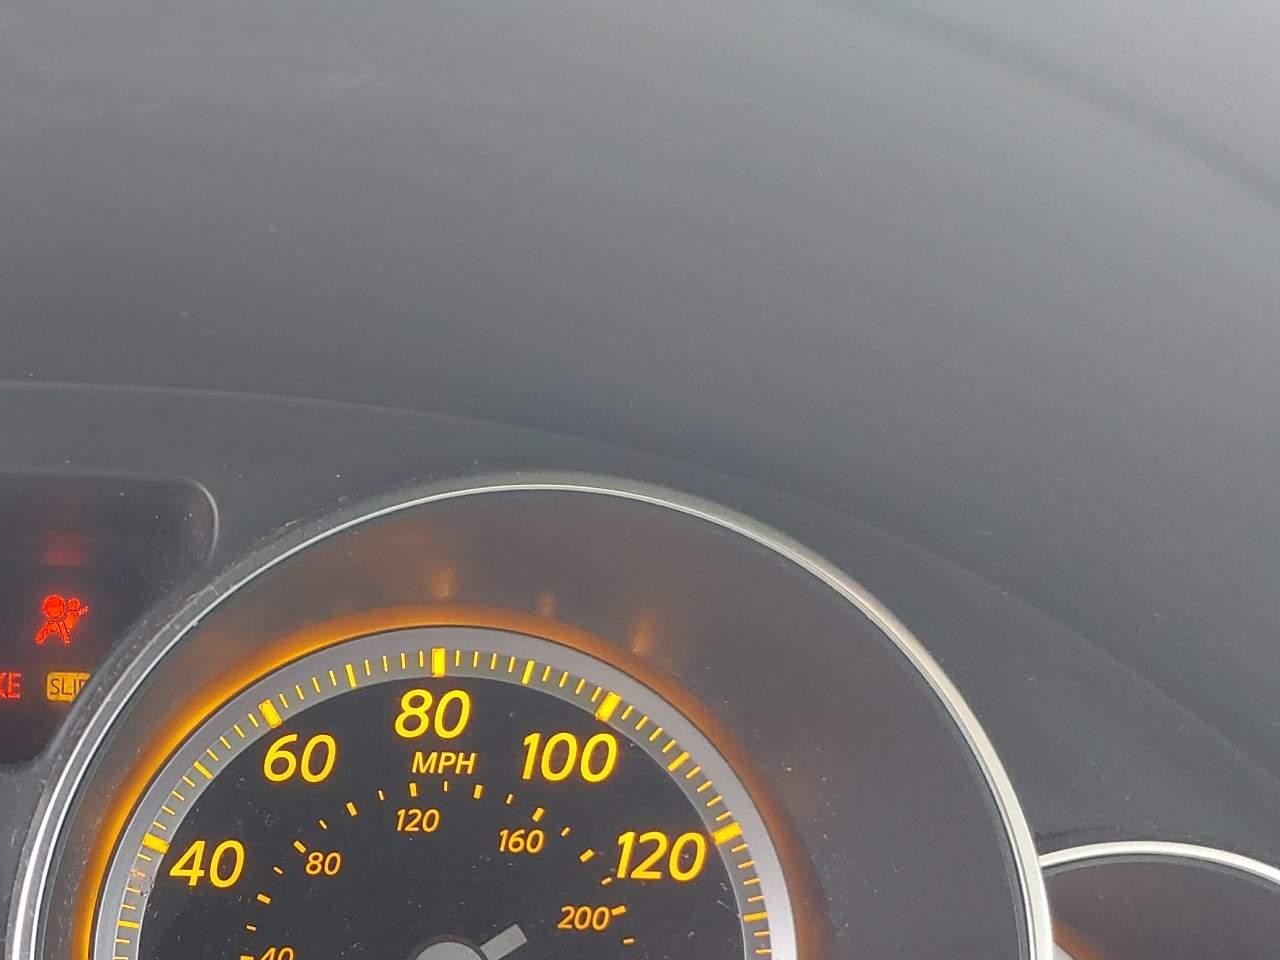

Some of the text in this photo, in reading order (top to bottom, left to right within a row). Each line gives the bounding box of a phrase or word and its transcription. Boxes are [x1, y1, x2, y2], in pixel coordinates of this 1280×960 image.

[394, 689, 471, 739] 80
[263, 733, 336, 783] 60
[411, 751, 476, 774] MPH
[521, 732, 617, 782] 100
[395, 808, 440, 832] 120
[498, 829, 544, 853] 160
[616, 831, 706, 881] 120
[169, 839, 245, 888] 40
[305, 851, 341, 876] 80
[557, 905, 610, 931] 200
